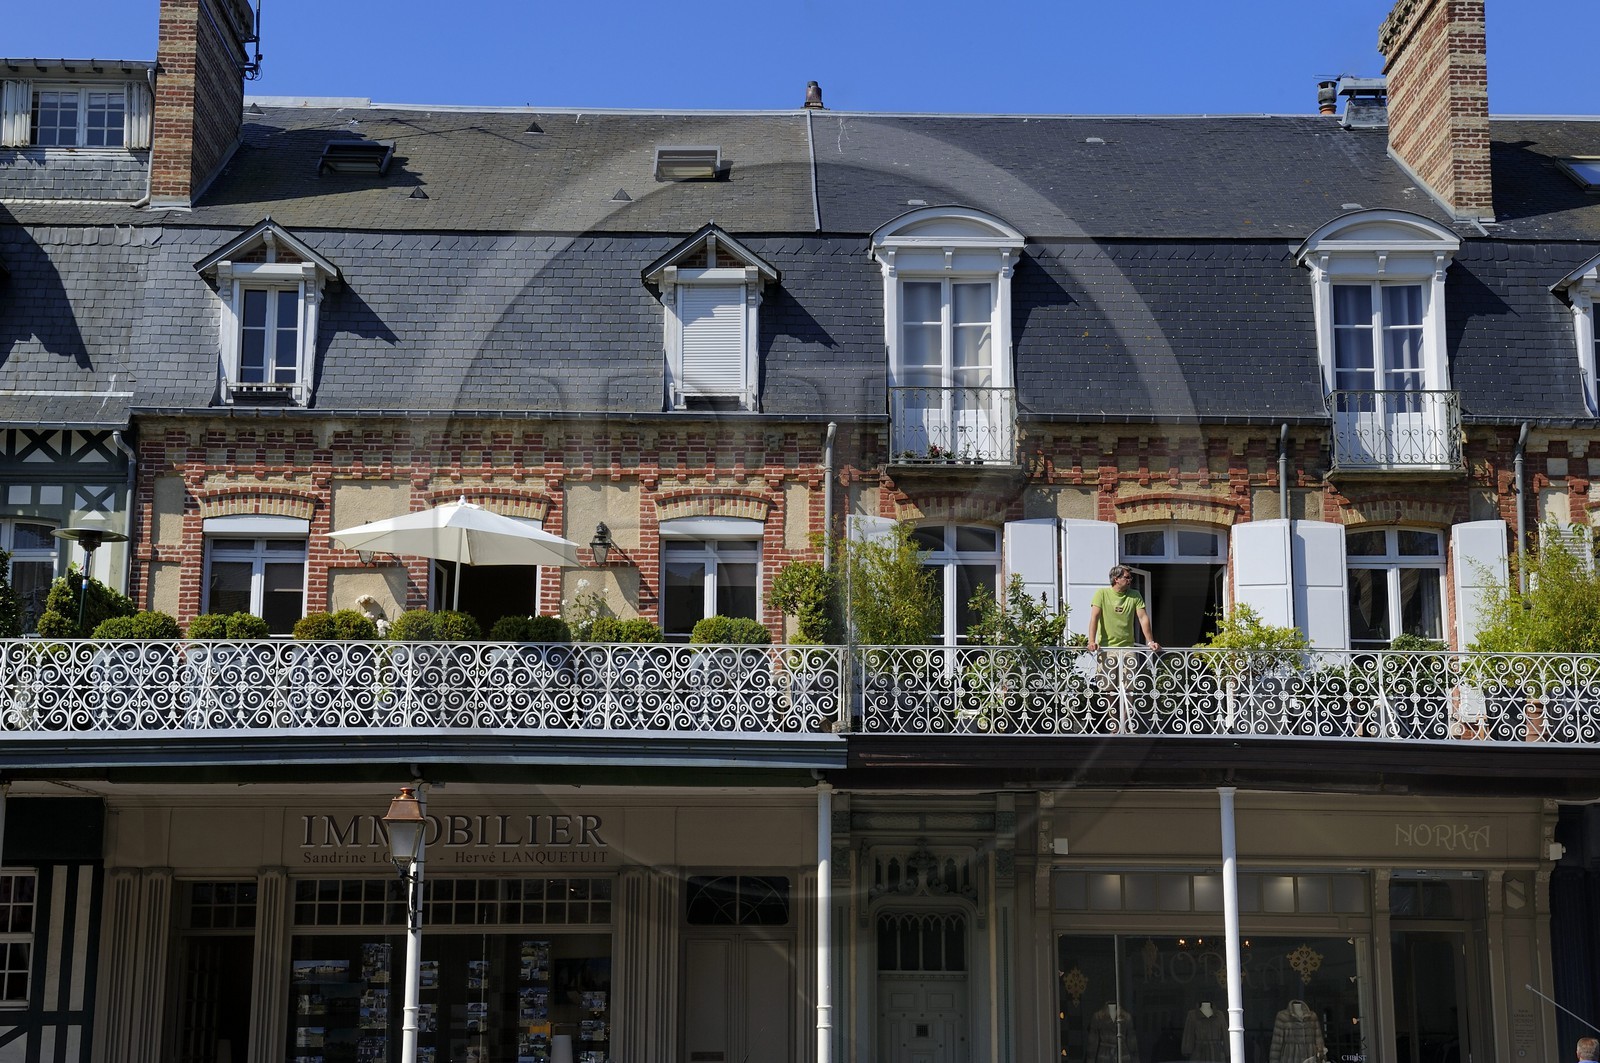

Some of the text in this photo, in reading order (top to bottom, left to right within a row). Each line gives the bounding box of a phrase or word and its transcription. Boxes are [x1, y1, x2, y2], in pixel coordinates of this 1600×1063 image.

[1395, 823, 1491, 852] NORKA
[303, 851, 366, 863] Sandrine
[455, 851, 496, 863] Hervé
[502, 851, 608, 864] LANQUETUIT
